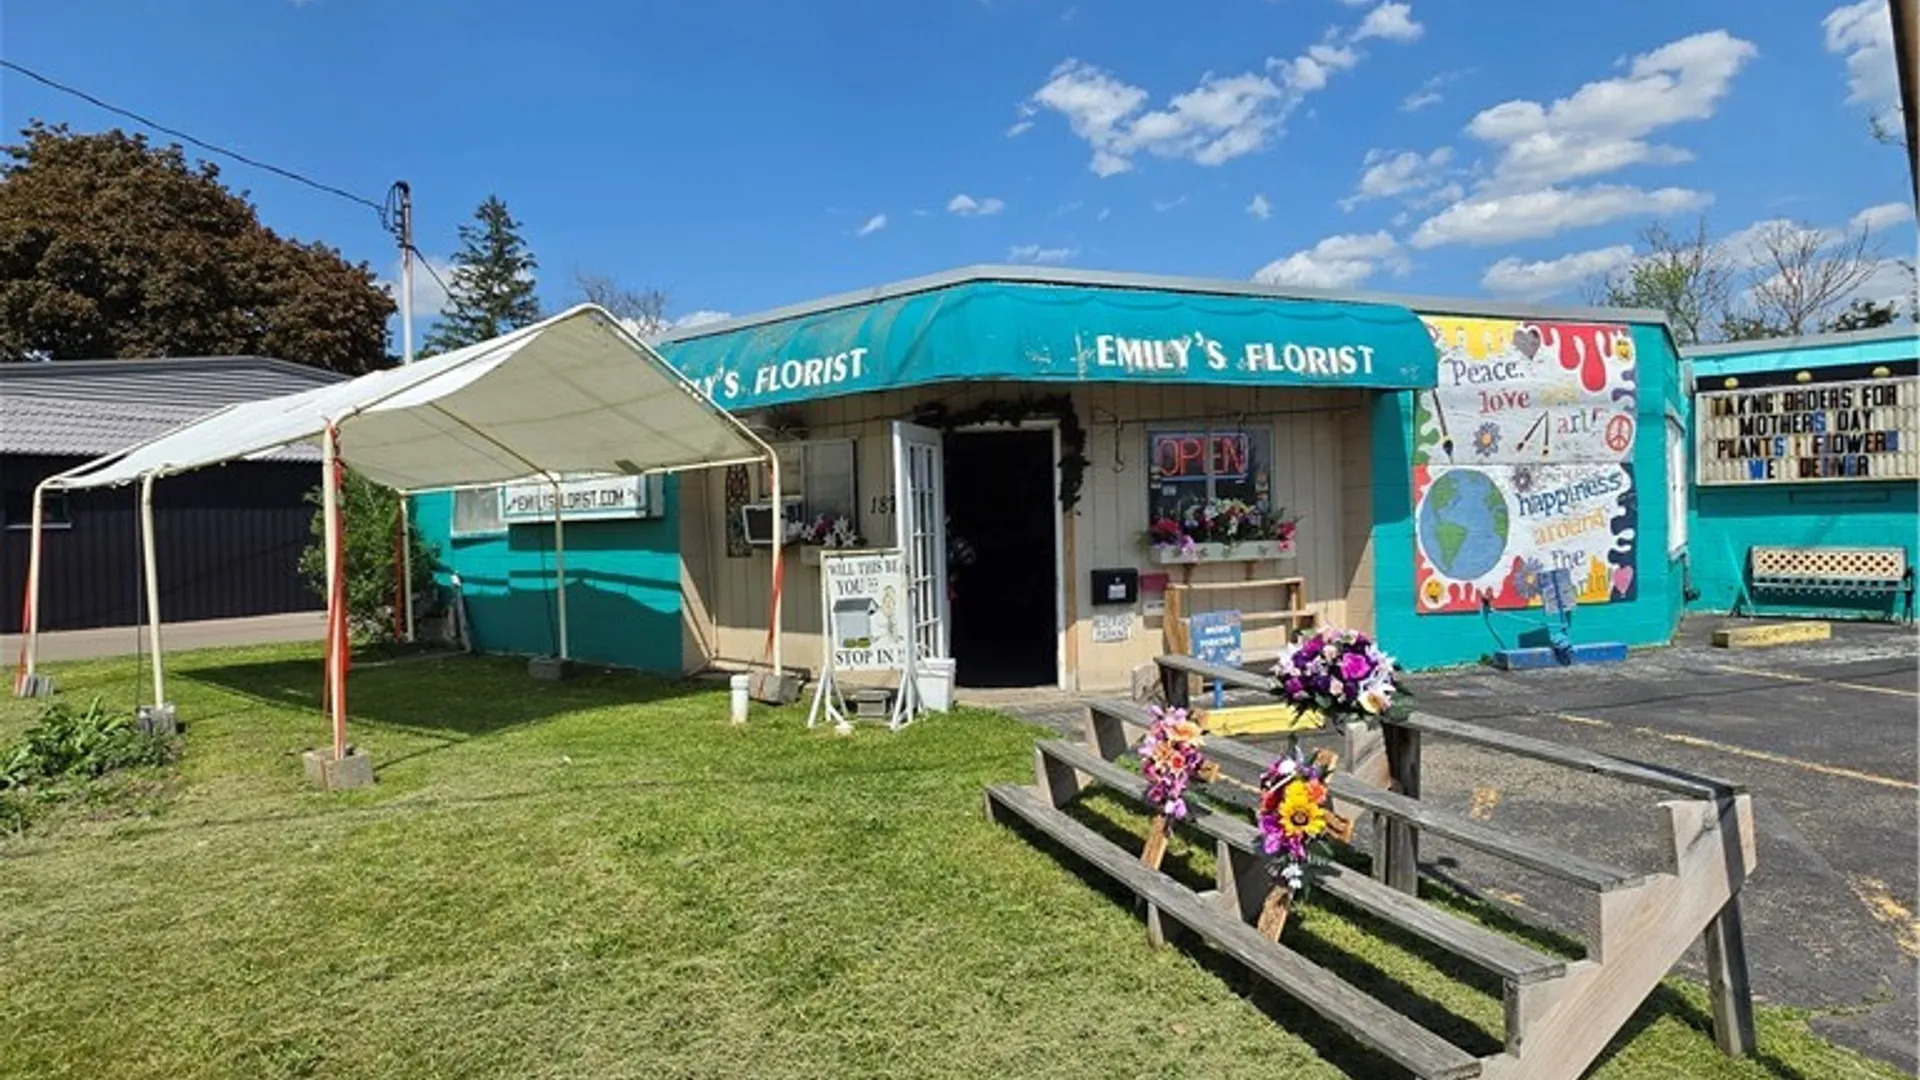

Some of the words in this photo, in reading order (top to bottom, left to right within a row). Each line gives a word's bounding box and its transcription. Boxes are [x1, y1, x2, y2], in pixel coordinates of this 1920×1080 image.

[1096, 331, 1227, 371] EMILY'S
[1245, 342, 1375, 375] FLORIST
[754, 347, 869, 395] FLORIST
[1477, 389, 1531, 413] love
[1783, 387, 1852, 412] ORDERS
[1863, 384, 1897, 406] FOR
[1739, 410, 1826, 436] MOTHERS
[1837, 408, 1873, 432] DAY
[1155, 437, 1246, 476] OPEN
[1717, 435, 1785, 459] PLANTS
[1748, 458, 1776, 479] WE
[1515, 471, 1622, 517] happiness
[858, 560, 883, 575] THIS
[836, 577, 863, 595] YOU
[835, 649, 874, 665] STOP
[877, 648, 896, 664] IN
